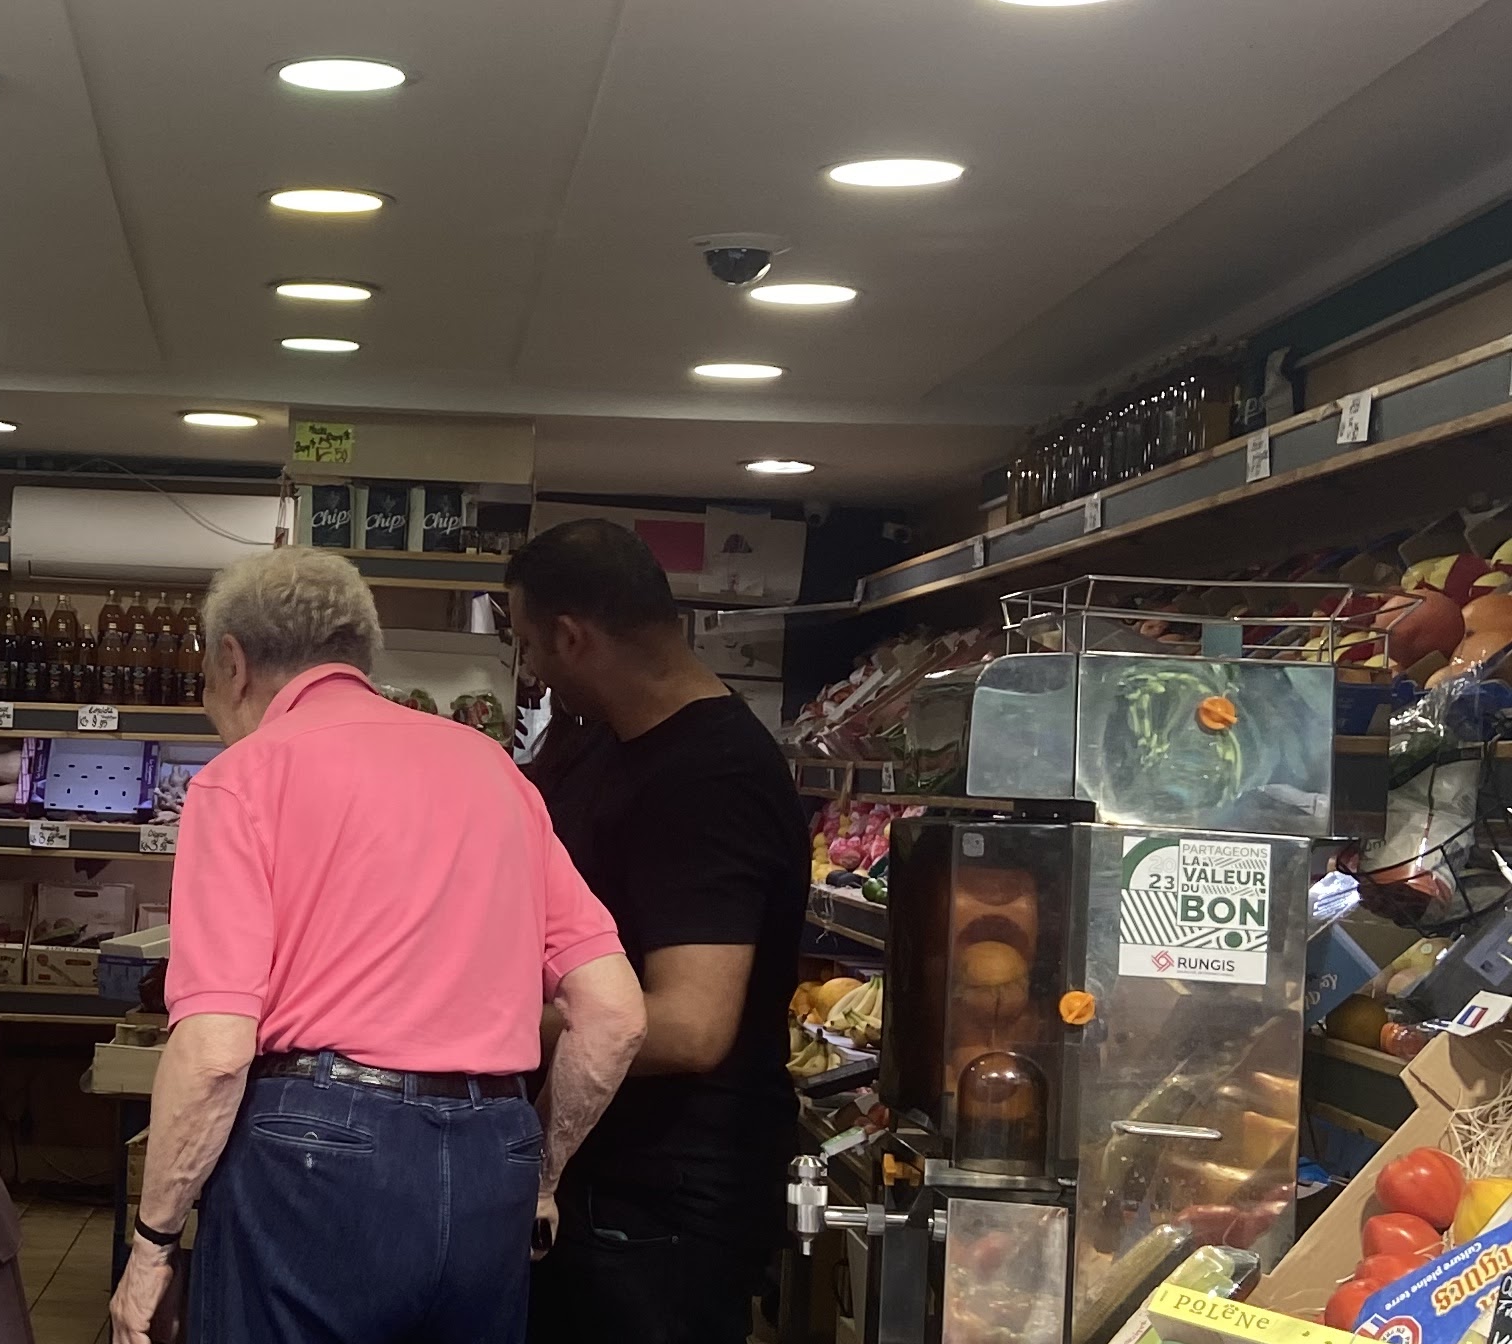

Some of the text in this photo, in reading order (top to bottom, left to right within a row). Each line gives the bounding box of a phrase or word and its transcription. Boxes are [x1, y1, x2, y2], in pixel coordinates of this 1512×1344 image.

[312, 507, 351, 530] Chips
[366, 513, 406, 534] Chips
[423, 511, 462, 535] Chips
[1182, 843, 1268, 859] PARTAGEONS
[1182, 856, 1200, 867] LA
[1149, 873, 1175, 889] 23
[1182, 867, 1266, 886] VALEUR
[1181, 883, 1199, 893] DU
[1180, 894, 1266, 927] BON
[1177, 956, 1235, 972] RUNGIS
[1384, 1241, 1483, 1312] Culture pleine terre
